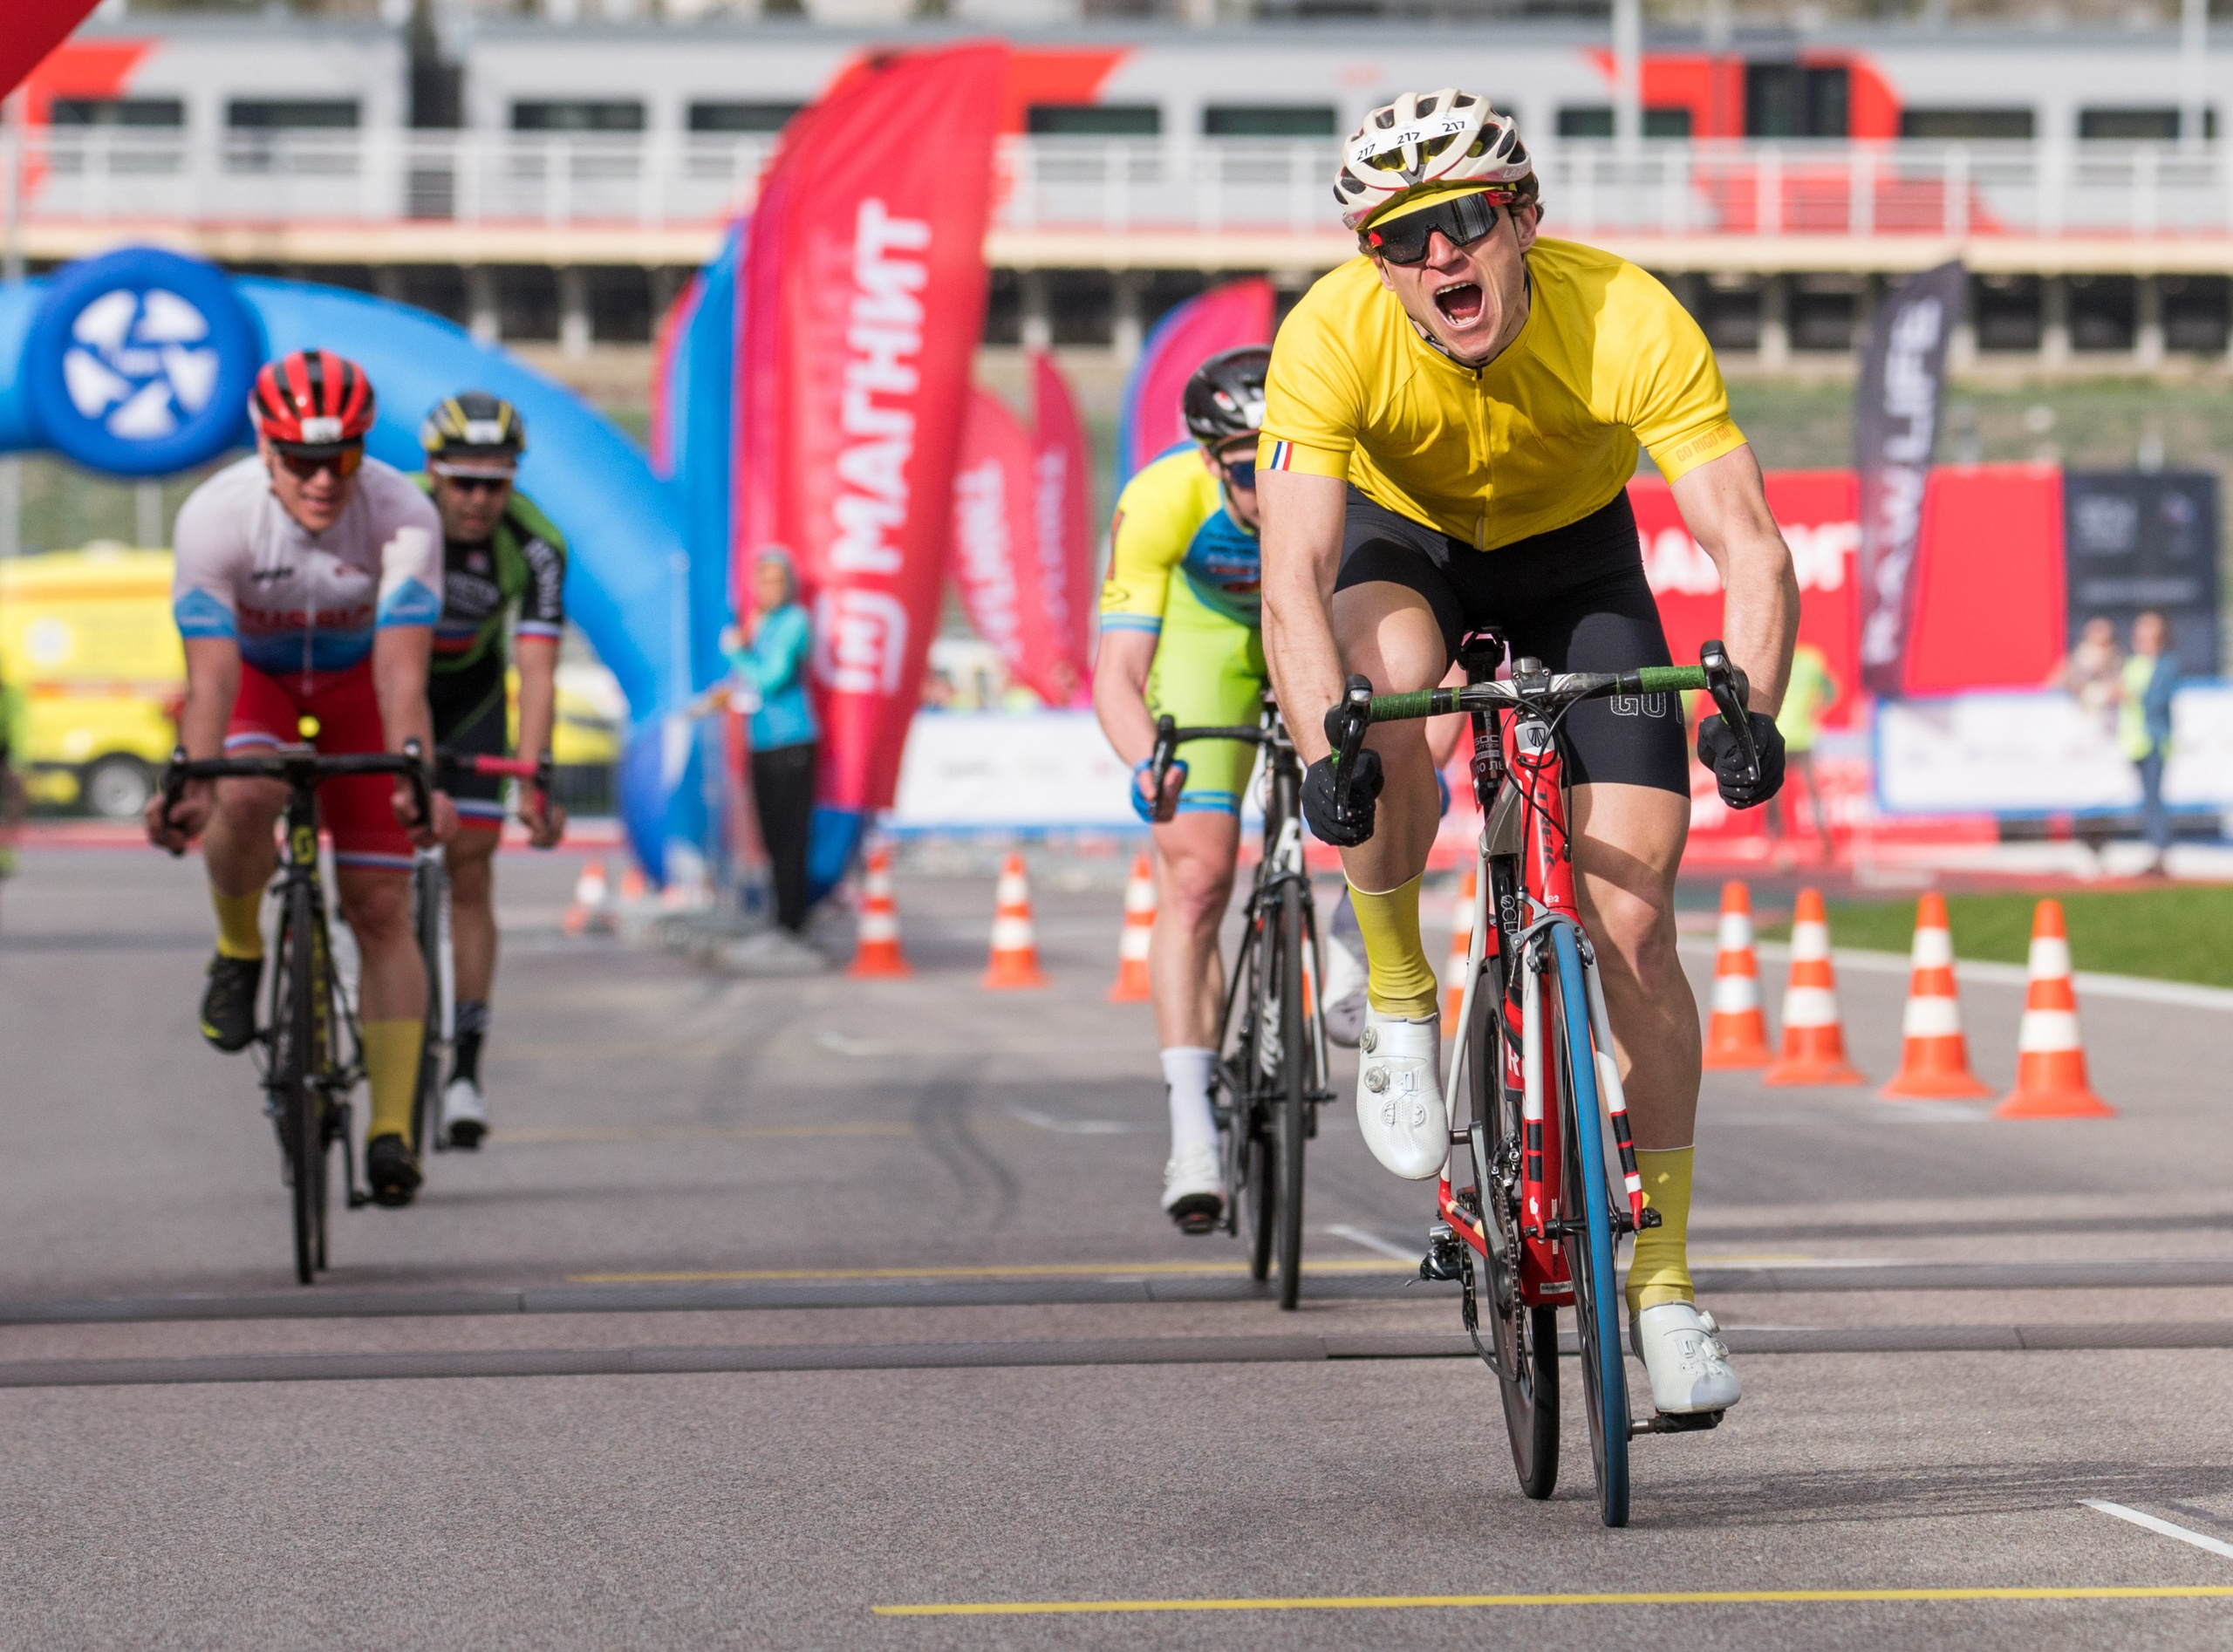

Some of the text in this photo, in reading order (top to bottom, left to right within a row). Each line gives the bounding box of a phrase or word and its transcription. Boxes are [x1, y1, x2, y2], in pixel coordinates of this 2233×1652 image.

[1396, 131, 1421, 146] 217
[1442, 120, 1466, 133] 217
[1356, 142, 1376, 162] 217
[829, 195, 932, 576] МАГНИТ
[1676, 445, 1693, 462] GO
[1691, 431, 1719, 454] RIGO
[1537, 787, 1556, 868] TREK
